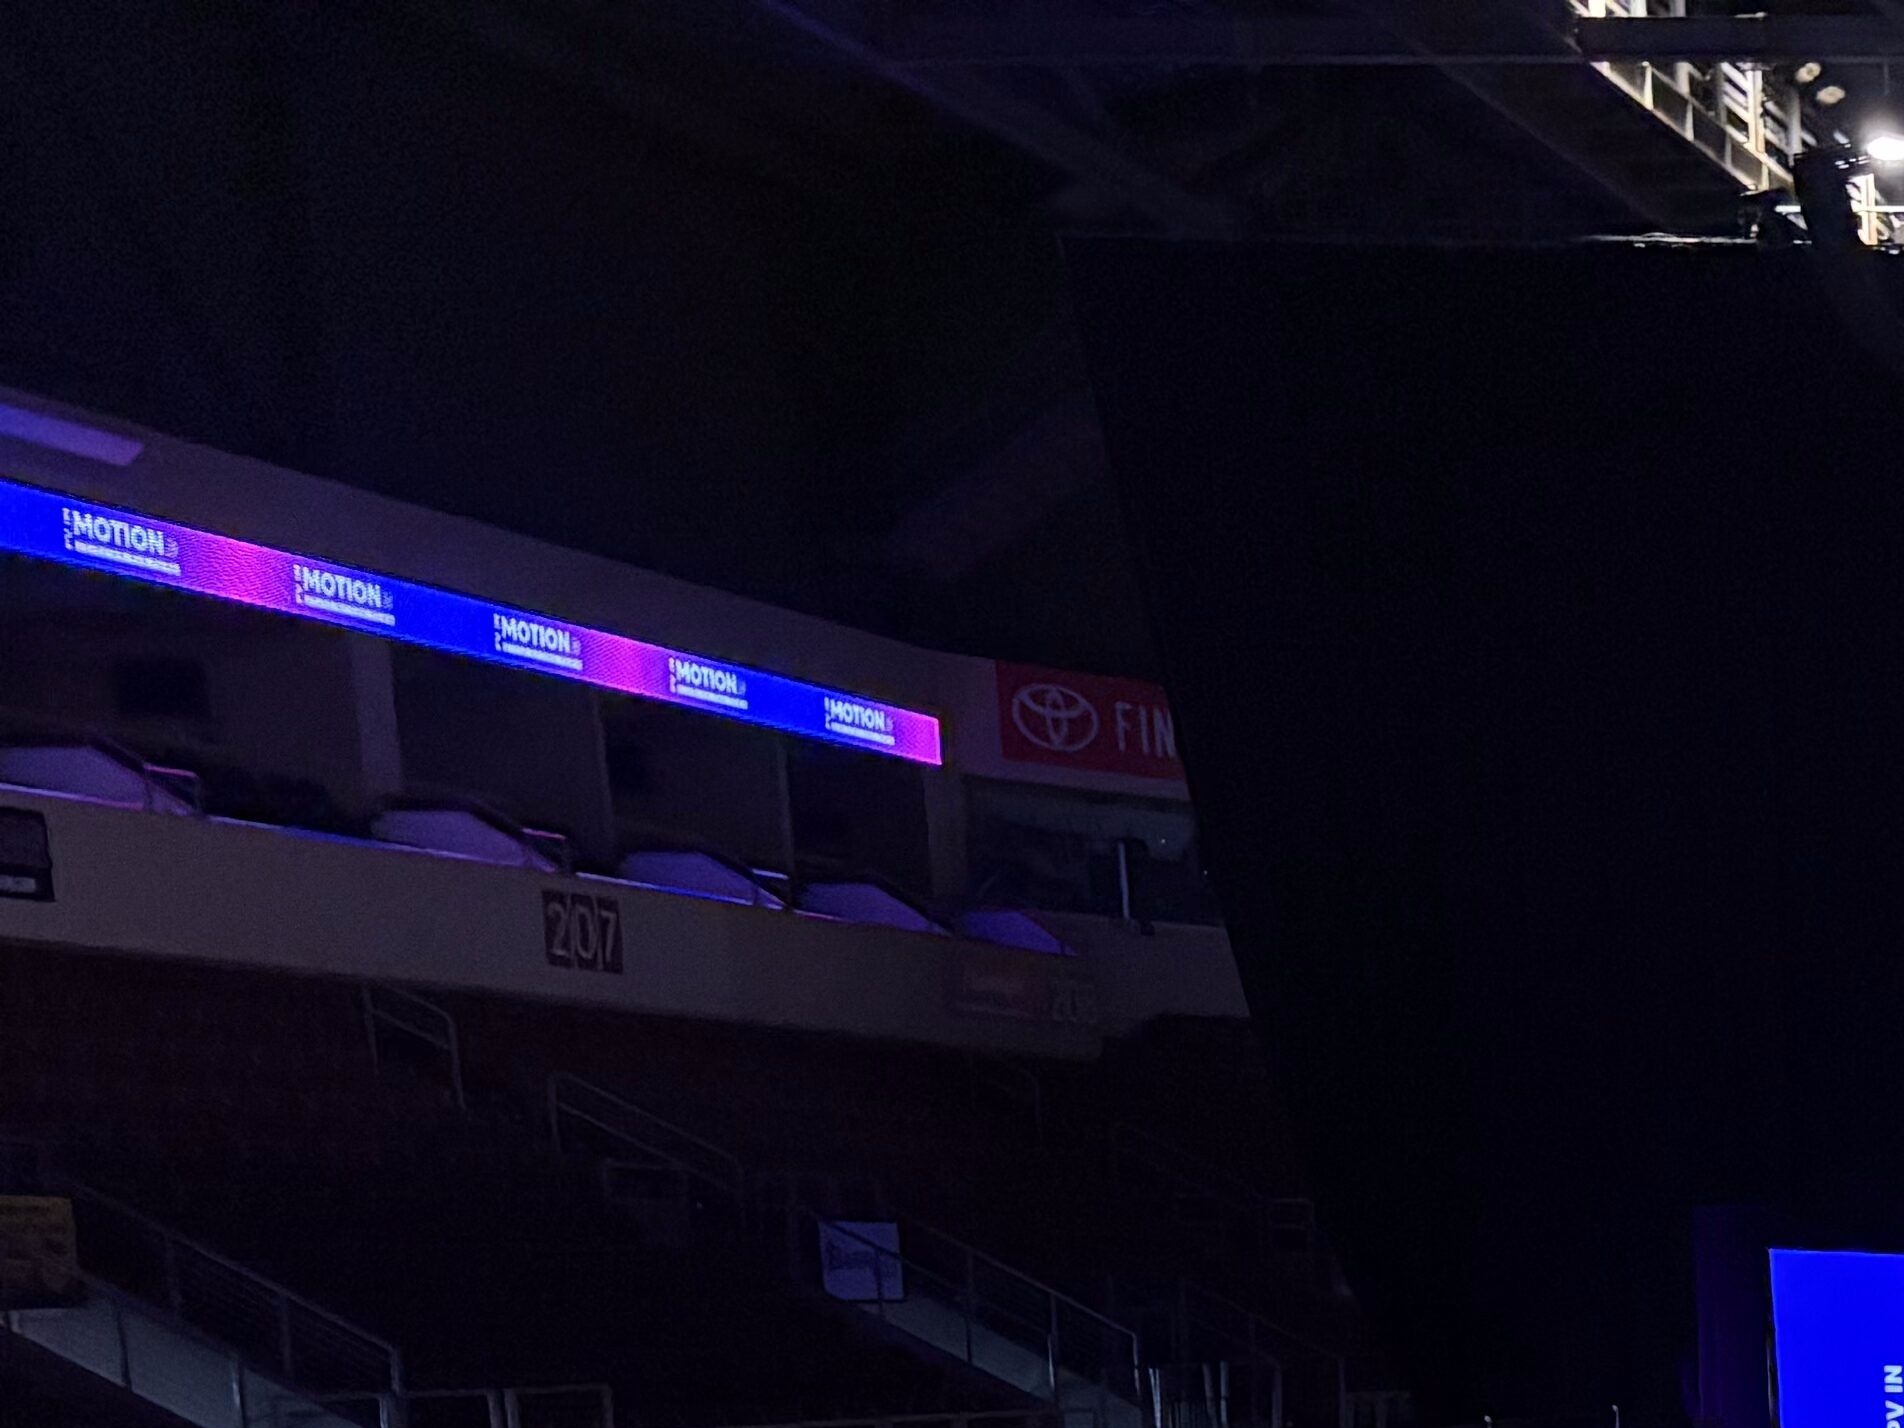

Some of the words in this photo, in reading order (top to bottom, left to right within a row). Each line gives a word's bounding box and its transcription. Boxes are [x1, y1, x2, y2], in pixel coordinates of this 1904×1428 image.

[72, 510, 166, 557] MOTION
[303, 568, 382, 608] MOTION
[500, 616, 571, 654] MOTION
[675, 659, 738, 695] MOTION
[829, 699, 885, 733] MOTION
[546, 900, 618, 963] 207
[1884, 1365, 1903, 1393] IN
